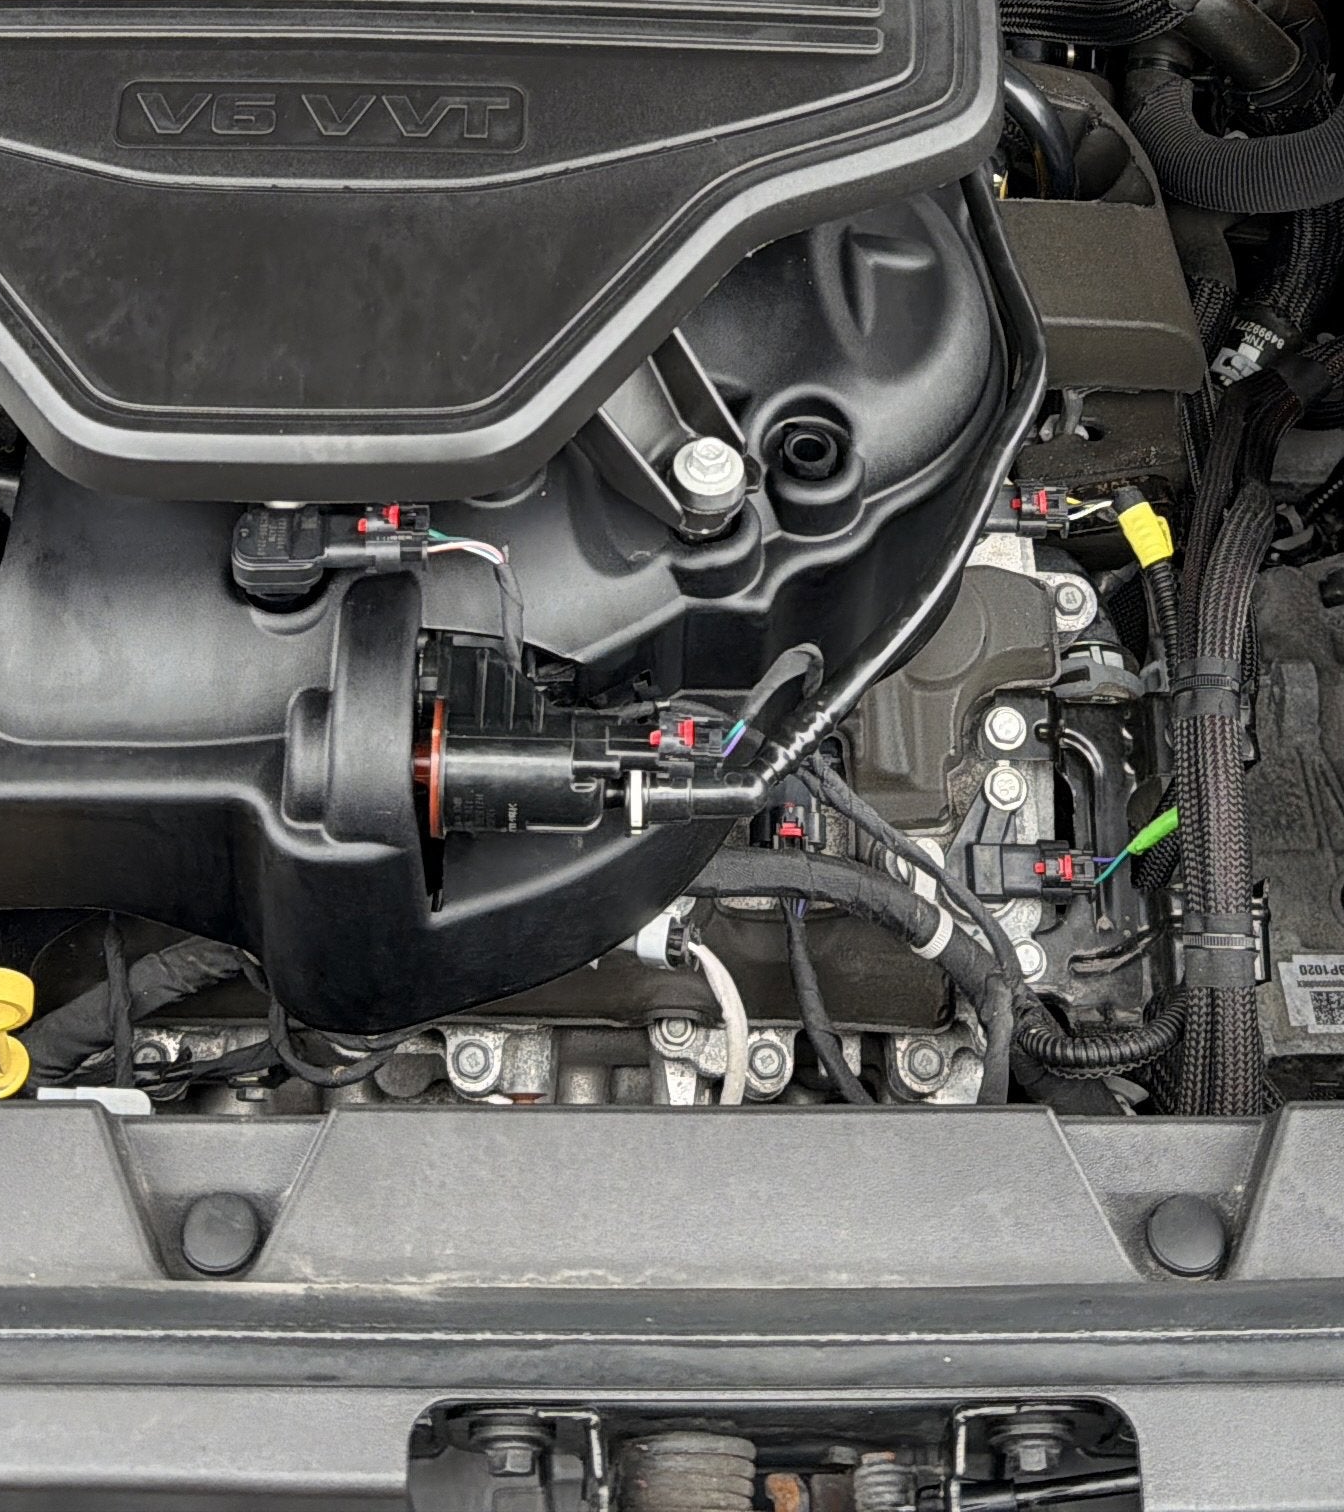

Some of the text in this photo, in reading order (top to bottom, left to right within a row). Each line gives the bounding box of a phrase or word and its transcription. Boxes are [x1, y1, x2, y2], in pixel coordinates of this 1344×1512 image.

[135, 91, 510, 138] V6 VVT
[1241, 331, 1265, 351] TNK
